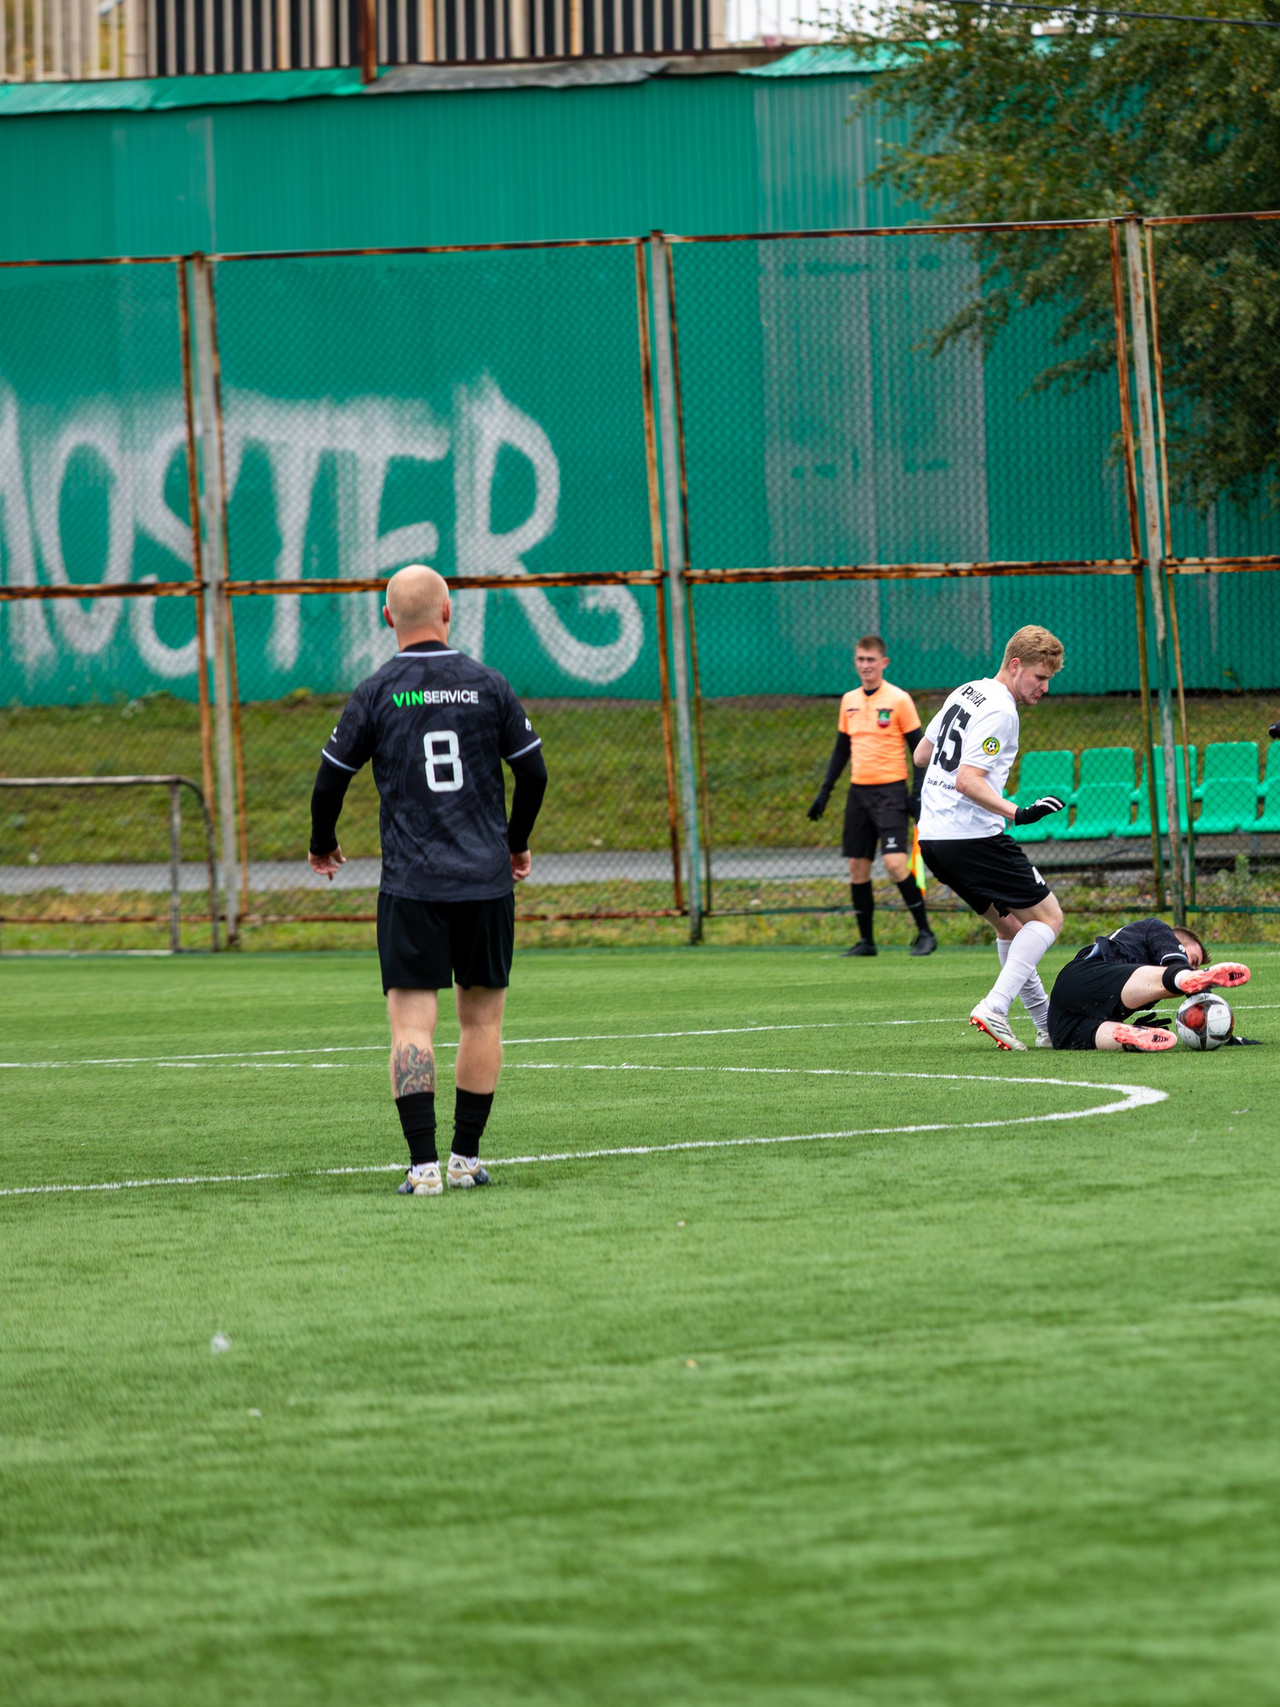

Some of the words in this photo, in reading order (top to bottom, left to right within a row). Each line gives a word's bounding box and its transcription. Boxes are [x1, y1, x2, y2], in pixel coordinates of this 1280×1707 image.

[393, 690, 479, 707] VINSERVICE
[423, 730, 464, 792] 8
[933, 704, 971, 772] 45
